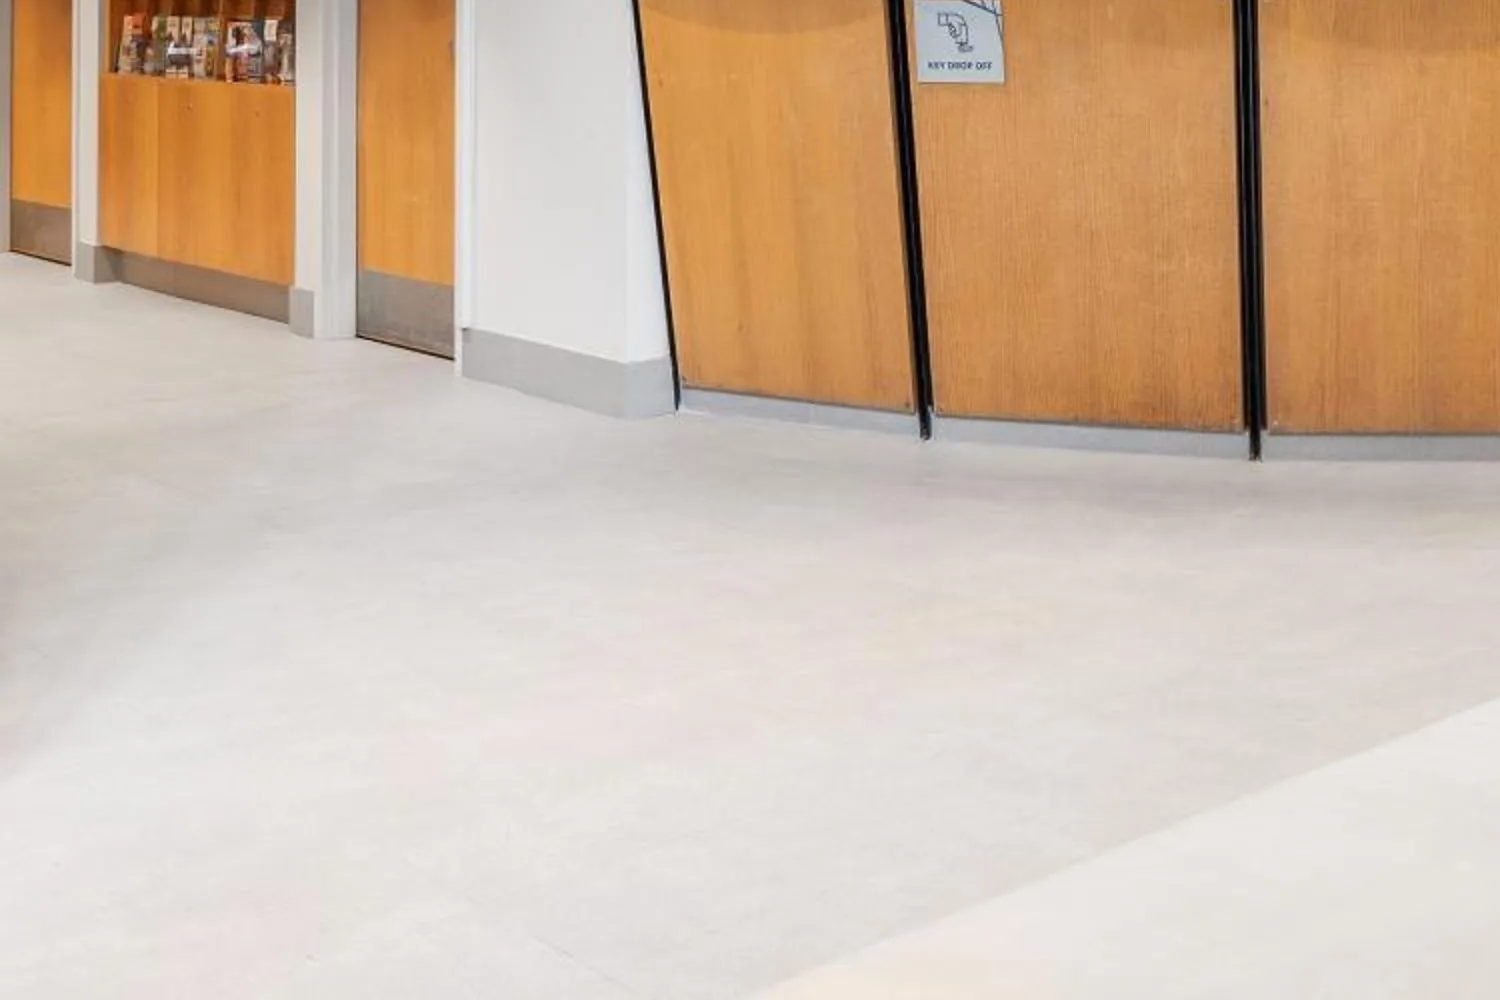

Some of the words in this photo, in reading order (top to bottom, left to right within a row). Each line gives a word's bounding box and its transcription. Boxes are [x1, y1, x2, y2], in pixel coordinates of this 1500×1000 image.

[927, 61, 945, 69] KEY
[947, 61, 973, 70] DROP
[975, 61, 993, 70] OFF
